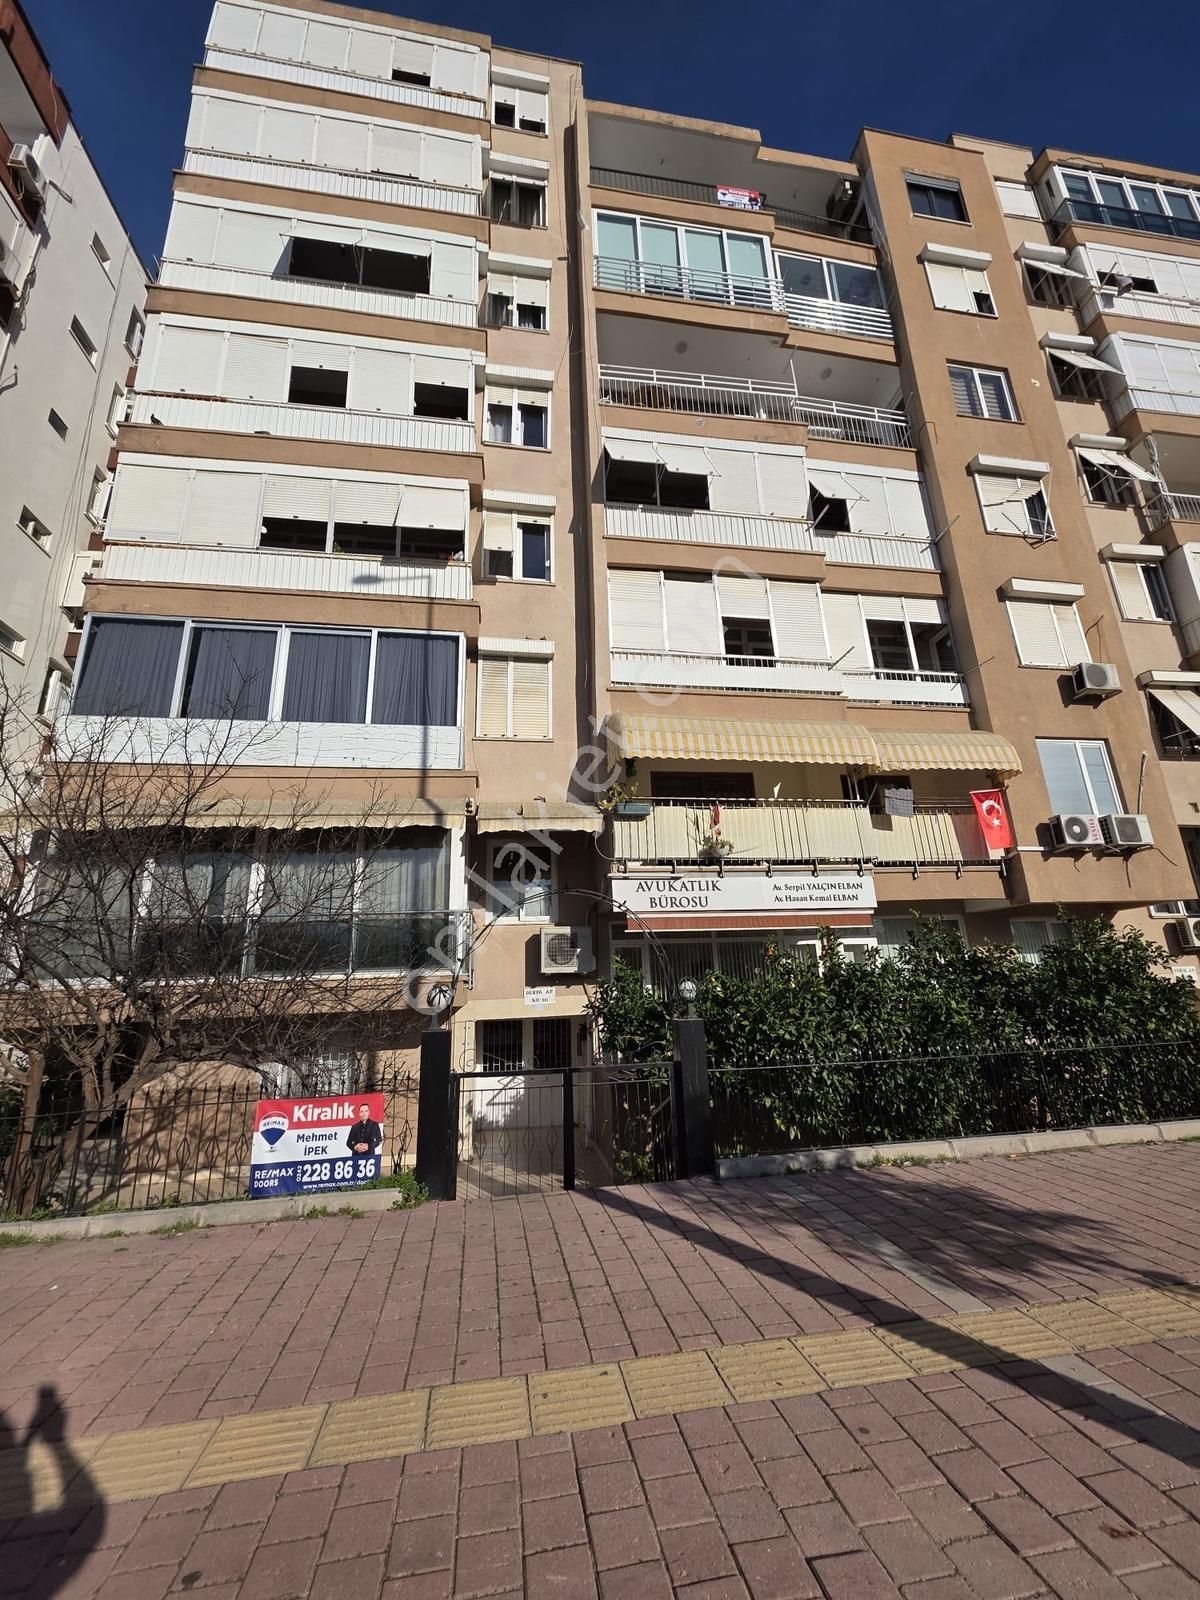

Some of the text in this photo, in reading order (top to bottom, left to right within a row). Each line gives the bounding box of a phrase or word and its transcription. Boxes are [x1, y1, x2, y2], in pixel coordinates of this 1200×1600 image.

[636, 880, 722, 893] AVUKATLIK
[784, 883, 806, 892] Serpil
[649, 895, 709, 909] BÜROSU
[808, 894, 832, 902] Kemal
[832, 894, 859, 902] ELBAN
[293, 1102, 355, 1122] Kiralık
[296, 1132, 338, 1143] Mehmet
[304, 1145, 328, 1156] İPEK
[254, 1167, 294, 1179] RE/MAX
[302, 1159, 376, 1182] 228 86 36
[254, 1179, 279, 1188] DOORS
